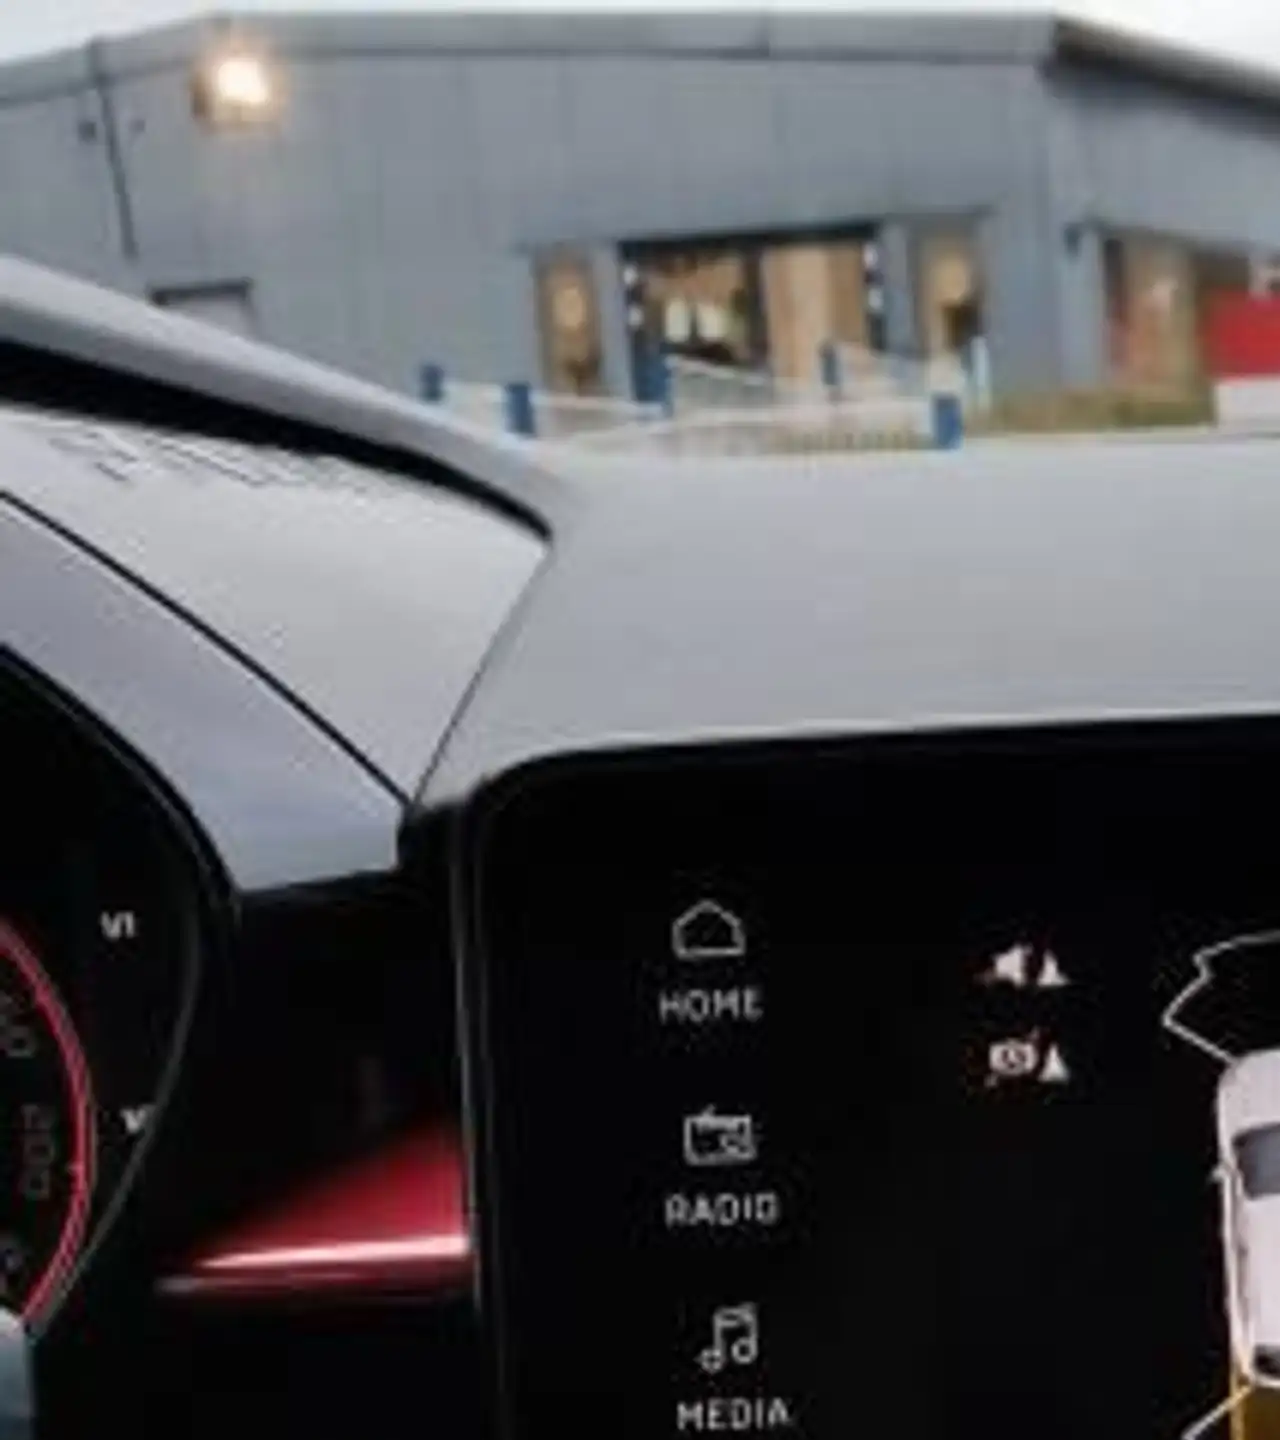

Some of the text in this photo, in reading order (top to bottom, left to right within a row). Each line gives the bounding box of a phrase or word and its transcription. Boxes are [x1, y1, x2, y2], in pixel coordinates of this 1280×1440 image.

[658, 986, 764, 1024] HOME
[664, 1191, 779, 1227] RADIO
[676, 1396, 792, 1431] MEDIA
